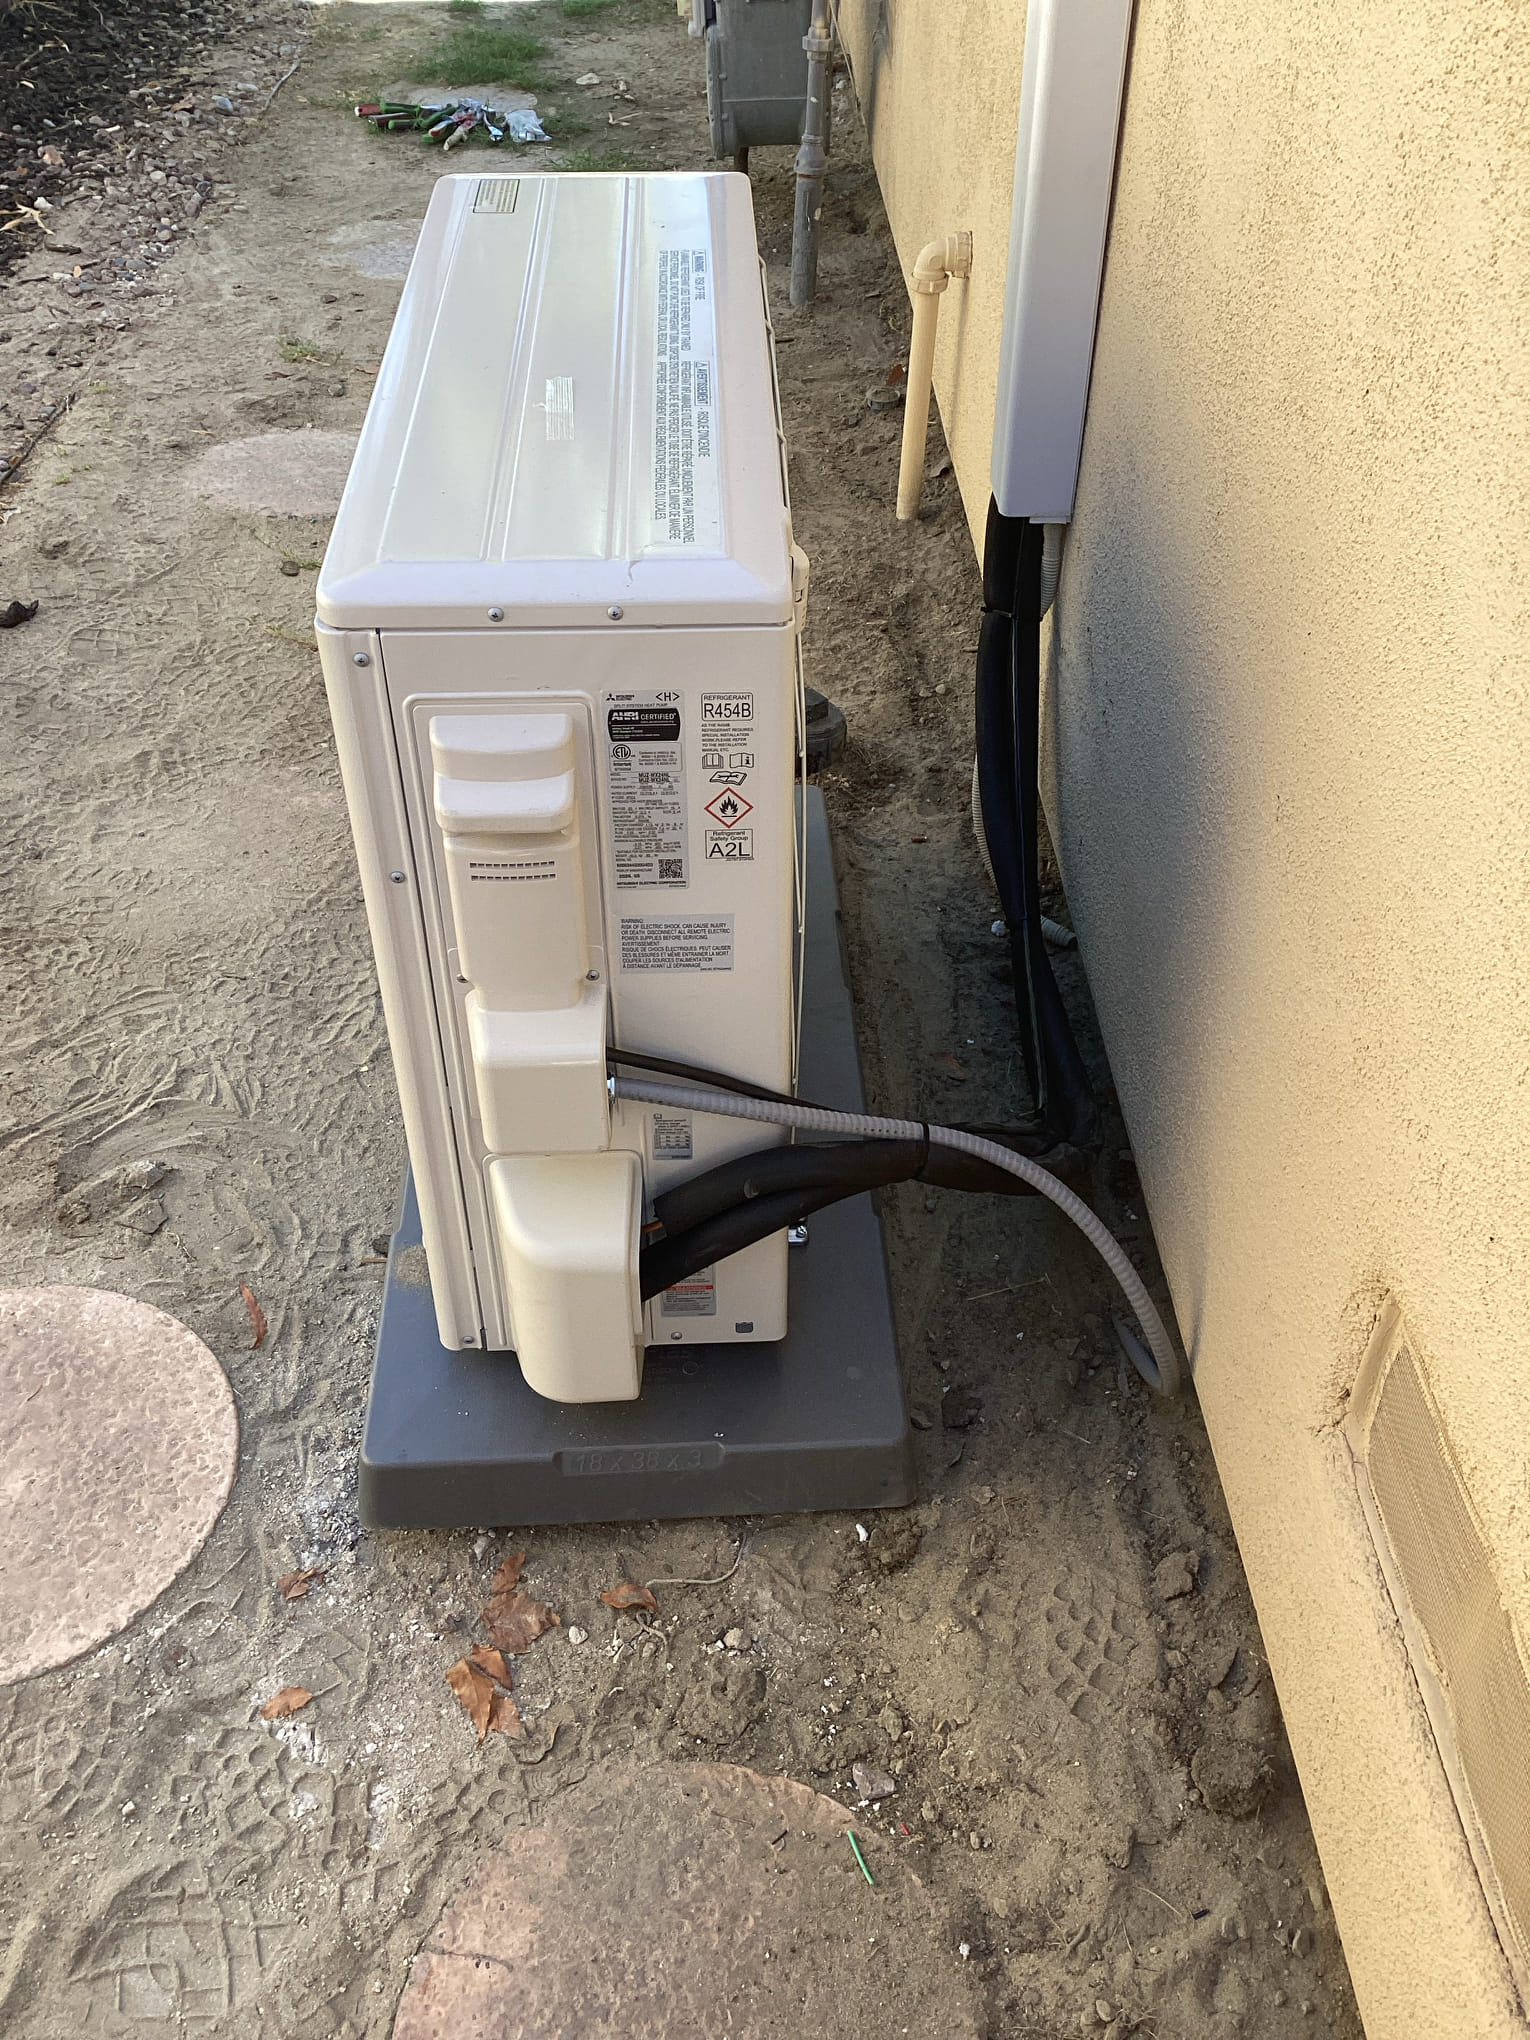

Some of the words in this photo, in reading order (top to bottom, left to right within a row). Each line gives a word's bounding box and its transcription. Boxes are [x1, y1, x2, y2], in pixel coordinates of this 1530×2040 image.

[611, 712, 639, 720] AHRI
[704, 703, 751, 718] R454B
[708, 842, 750, 857] A2L
